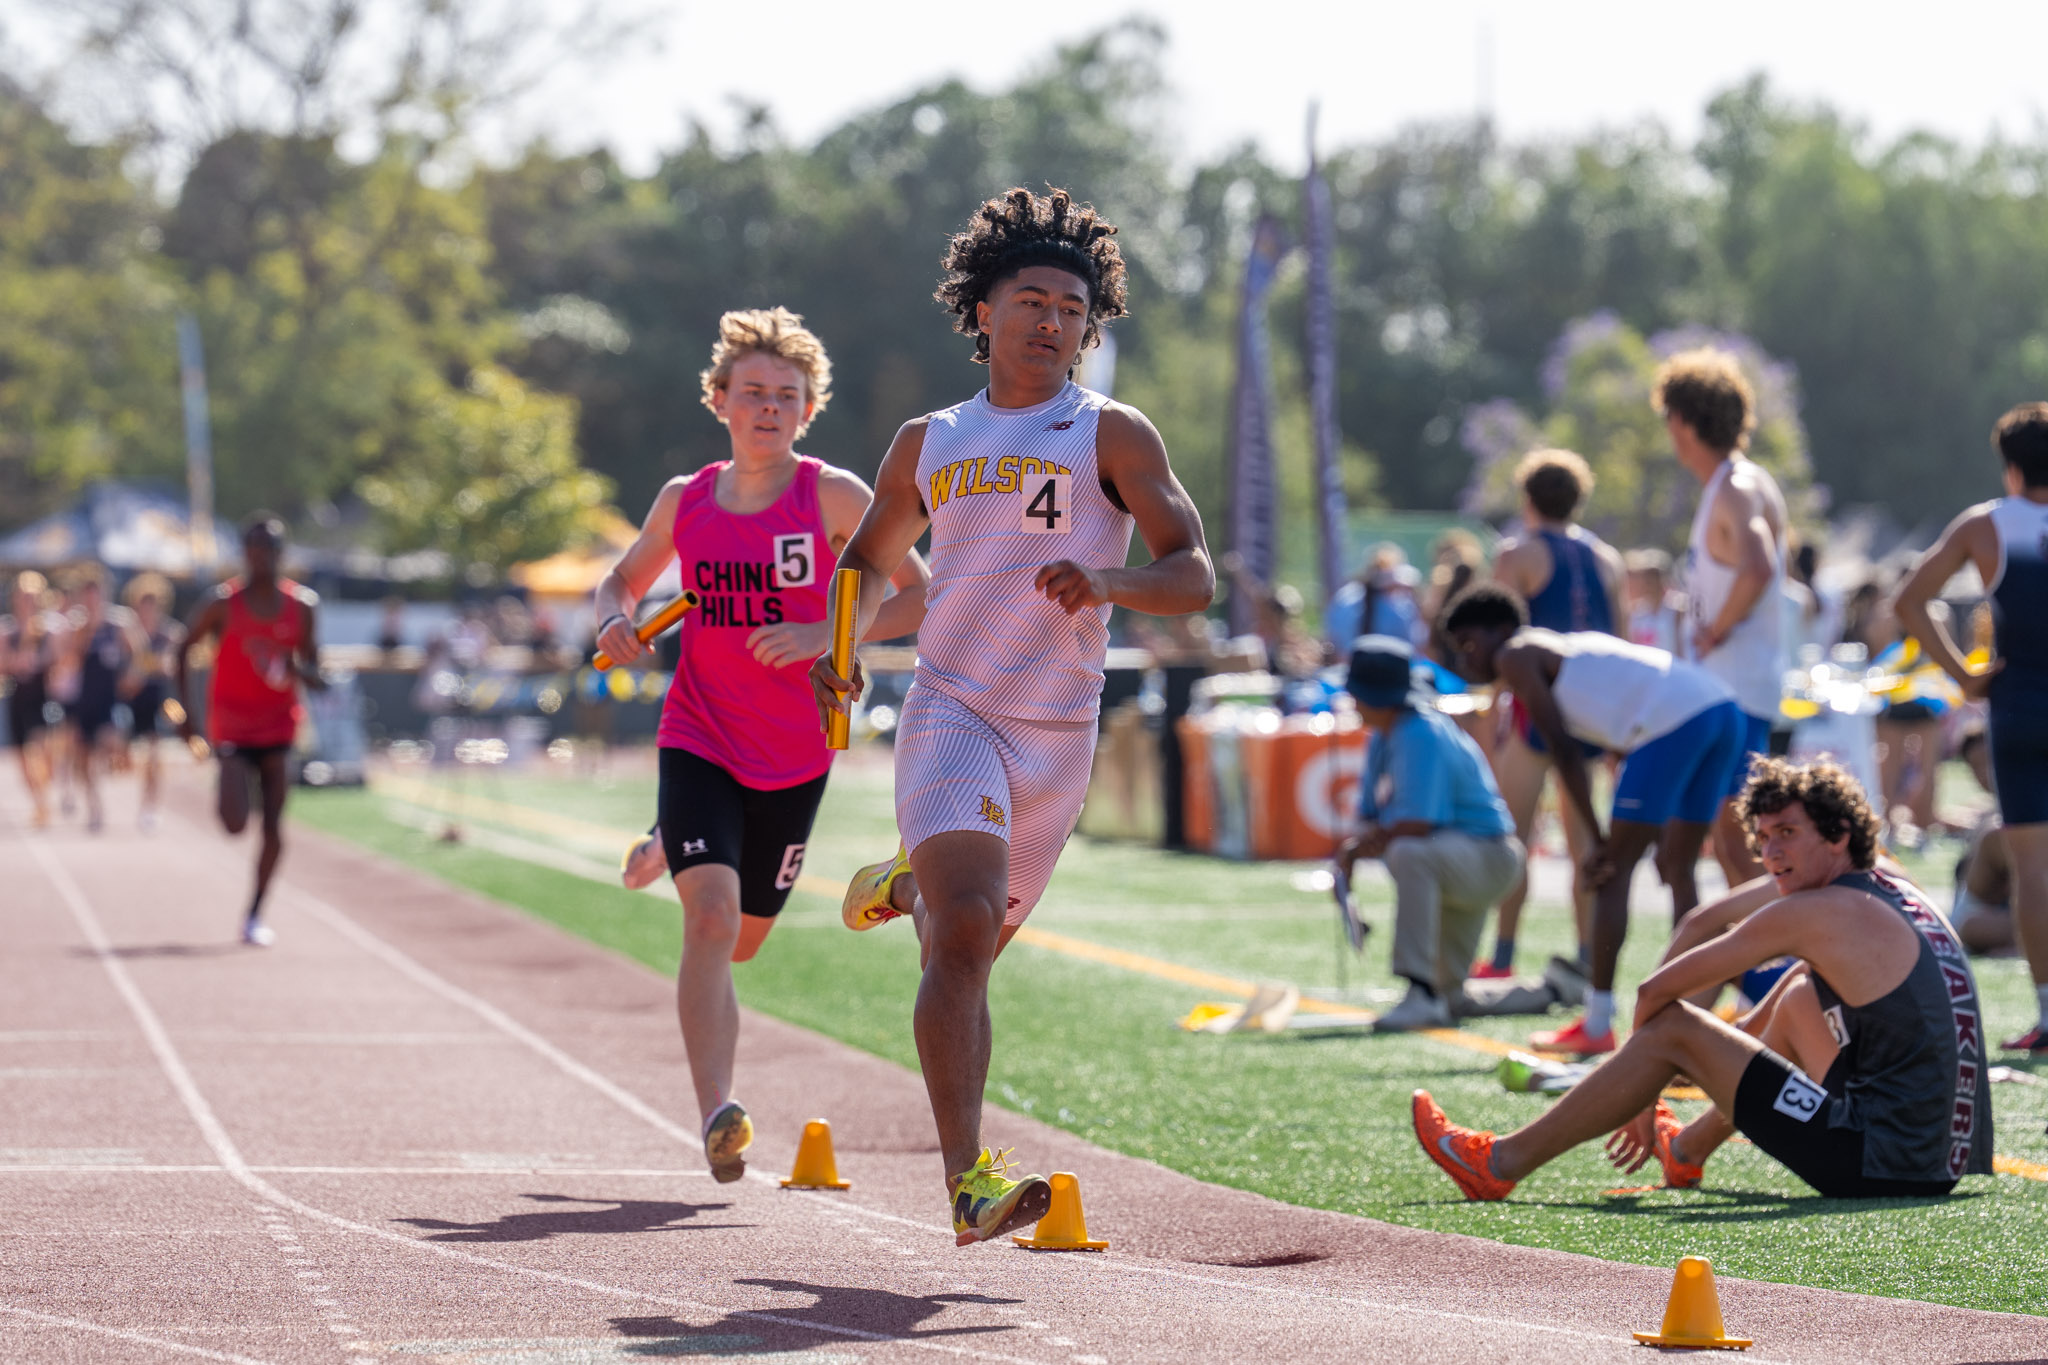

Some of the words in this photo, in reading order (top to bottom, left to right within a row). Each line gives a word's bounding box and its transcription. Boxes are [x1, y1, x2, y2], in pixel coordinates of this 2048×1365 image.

[1025, 479, 1062, 530] 4
[781, 538, 808, 582] 5
[700, 596, 783, 627] HILLS
[1782, 1076, 1823, 1112] 13
